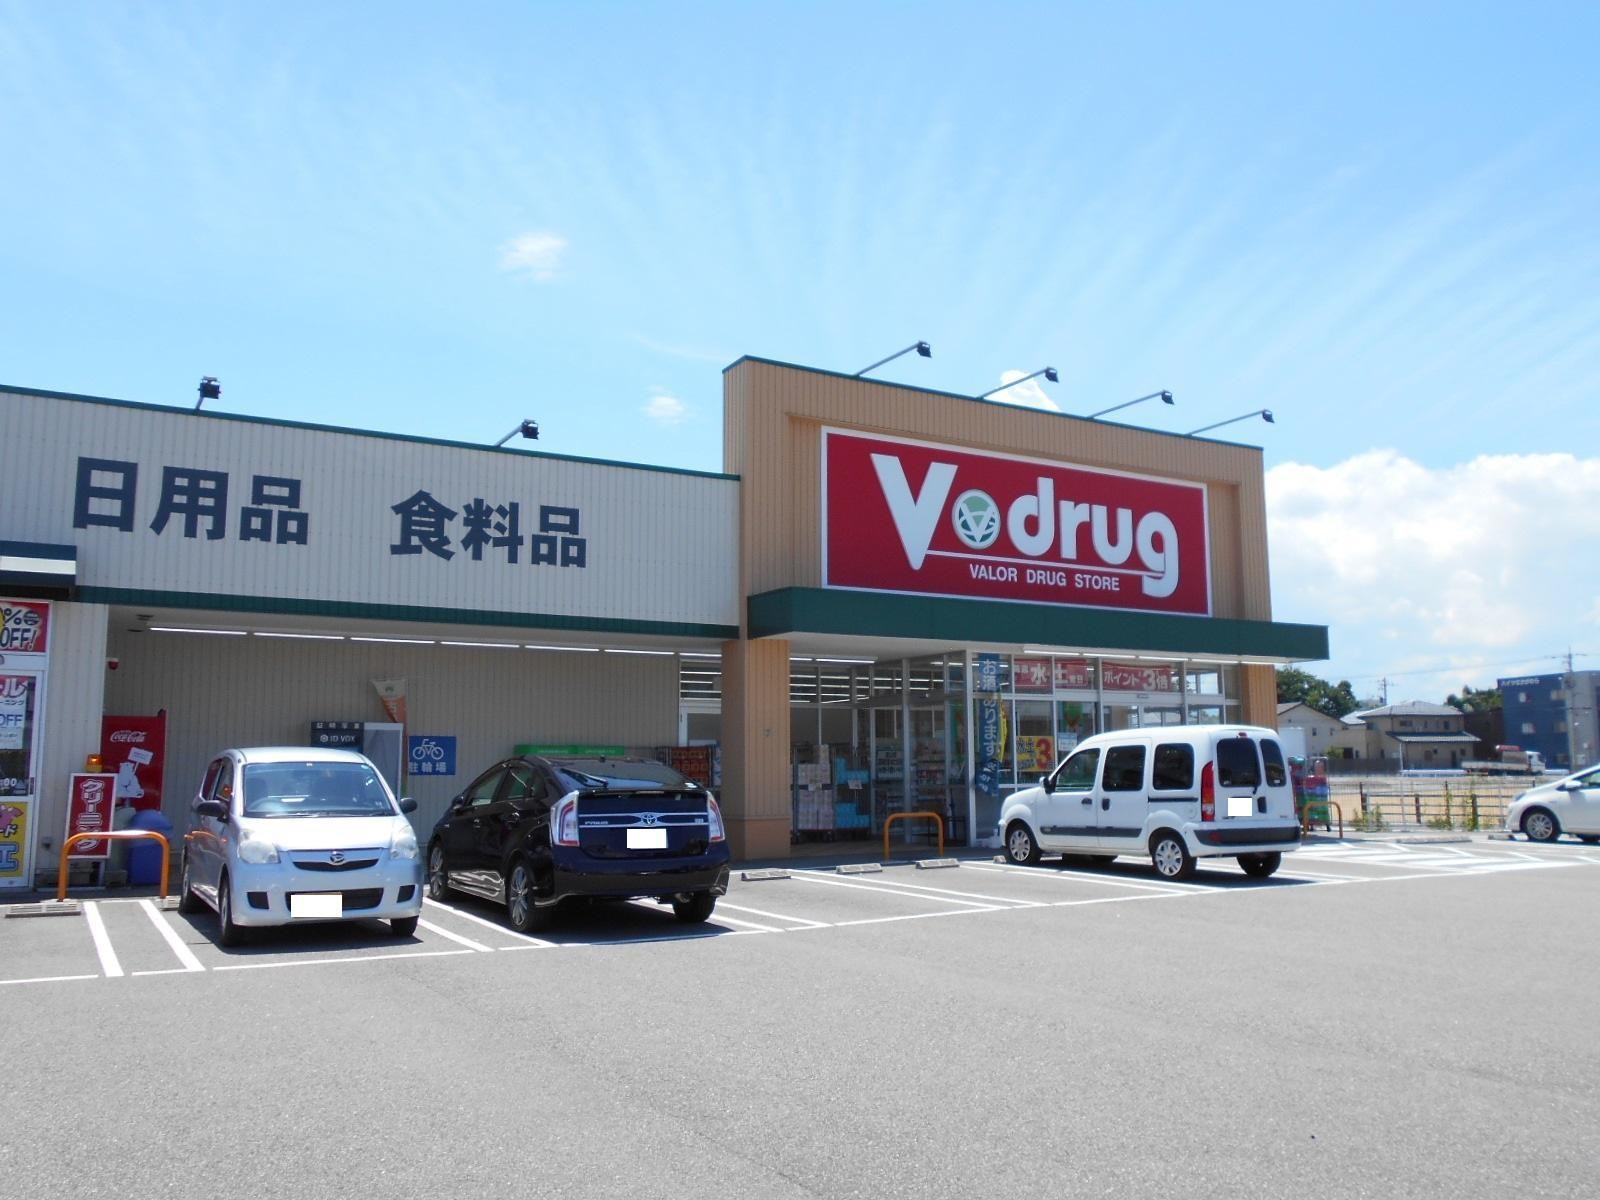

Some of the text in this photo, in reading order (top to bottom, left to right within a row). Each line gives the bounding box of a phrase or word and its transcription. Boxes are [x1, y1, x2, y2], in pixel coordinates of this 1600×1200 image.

[73, 457, 588, 569] 日用品 食料品
[969, 563, 1120, 592] VALOR DRUG STORE
[408, 762, 447, 773] 駐輪場
